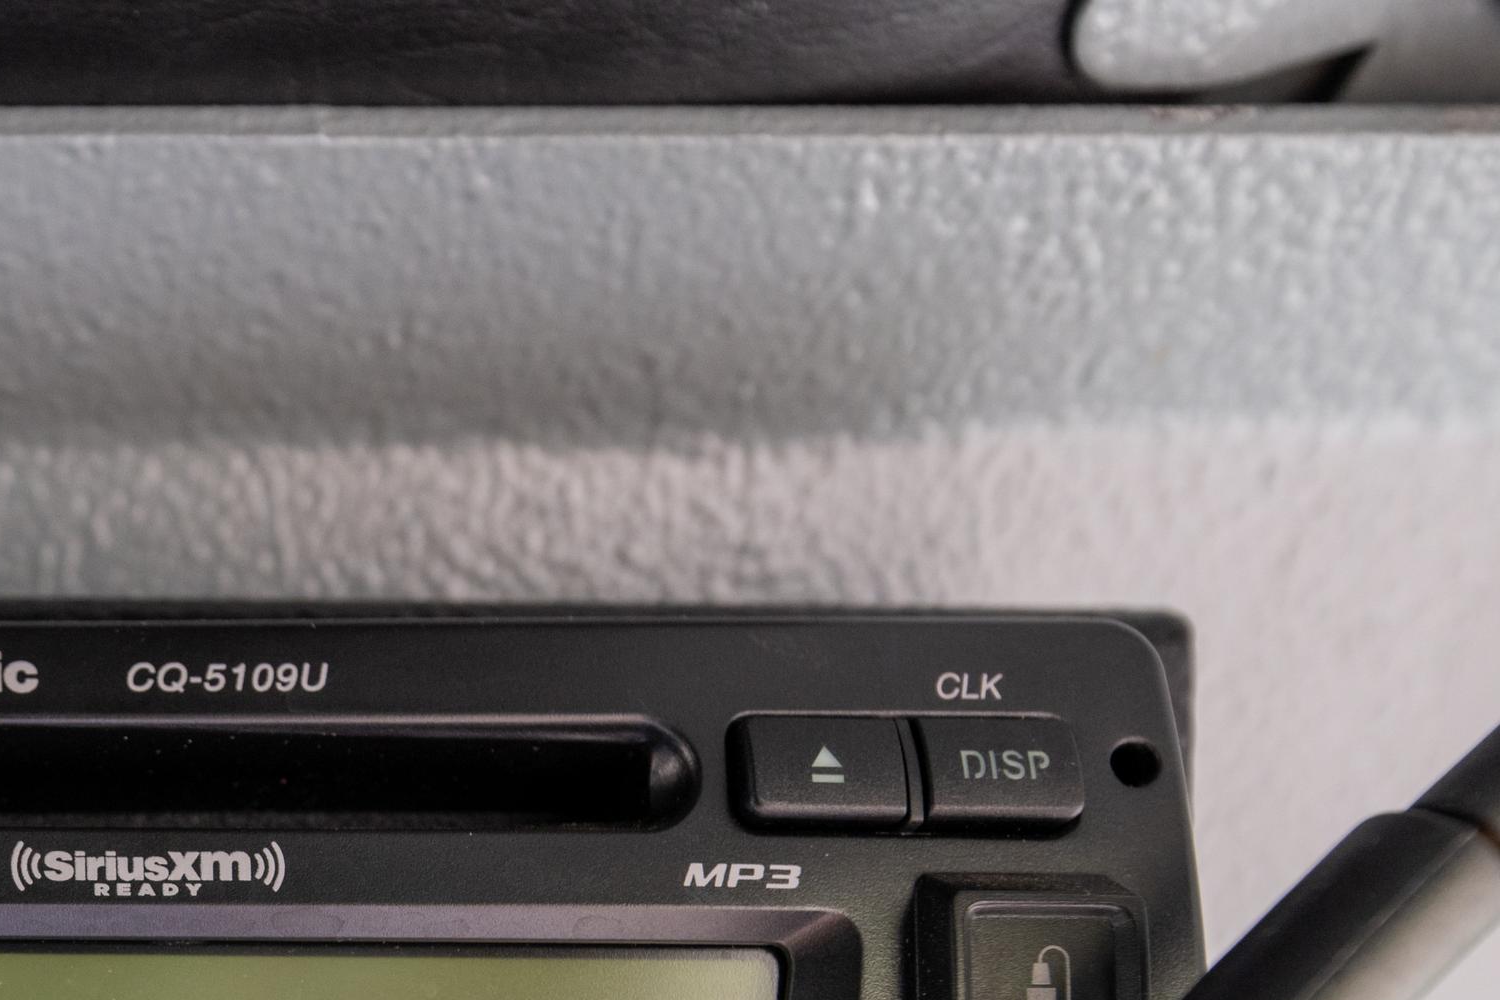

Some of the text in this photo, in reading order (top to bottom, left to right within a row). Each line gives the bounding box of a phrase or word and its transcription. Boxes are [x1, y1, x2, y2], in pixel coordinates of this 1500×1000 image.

[126, 661, 329, 693] CQ-5109U
[935, 671, 1003, 700] CLK
[960, 749, 1050, 781] DISP
[93, 882, 202, 897] READY
[683, 862, 802, 890] MP3
